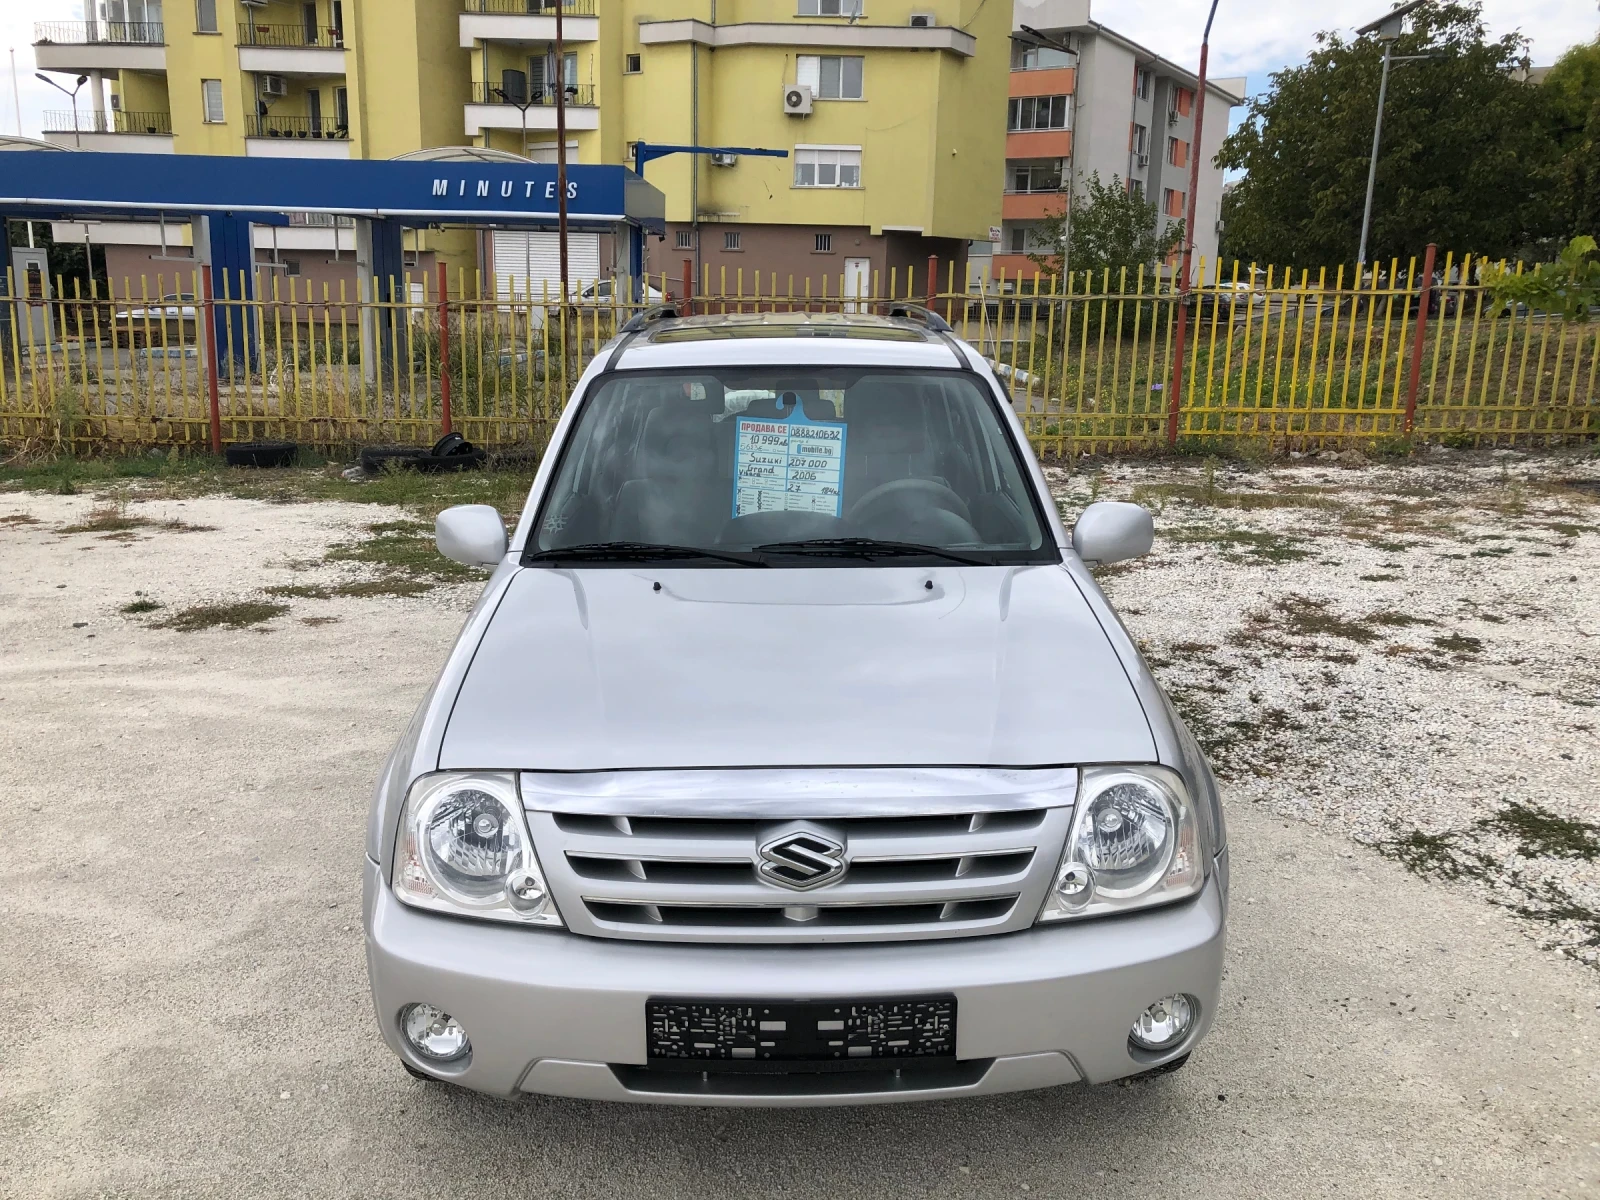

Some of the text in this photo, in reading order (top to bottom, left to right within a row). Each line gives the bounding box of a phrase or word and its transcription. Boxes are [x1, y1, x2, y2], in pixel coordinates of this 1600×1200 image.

[741, 422, 787, 434] ПРОДАВА СЕ
[802, 446, 832, 455] mobile.bg
[749, 452, 782, 464] Suzuki
[747, 464, 775, 474] Grand
[792, 471, 817, 480] 2006
